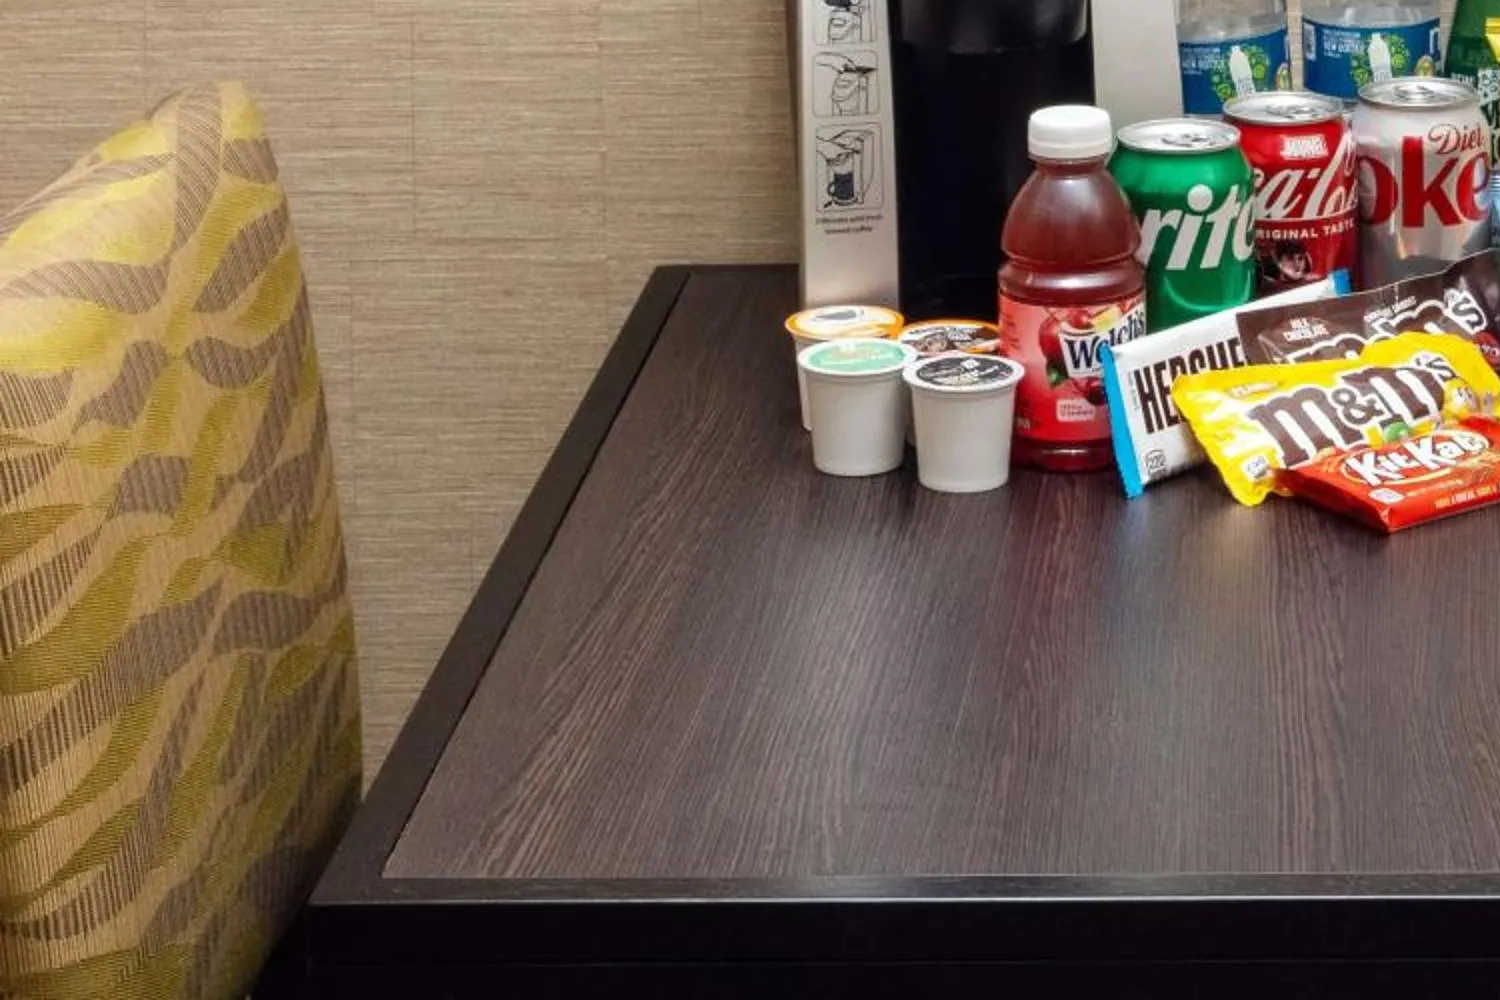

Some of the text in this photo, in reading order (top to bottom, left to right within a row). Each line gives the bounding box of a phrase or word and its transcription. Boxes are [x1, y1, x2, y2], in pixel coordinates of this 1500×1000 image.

[1427, 122, 1484, 155] Diet
[1358, 136, 1489, 228] oke
[1134, 183, 1255, 271] rite
[1255, 226, 1319, 239] RIGINAL
